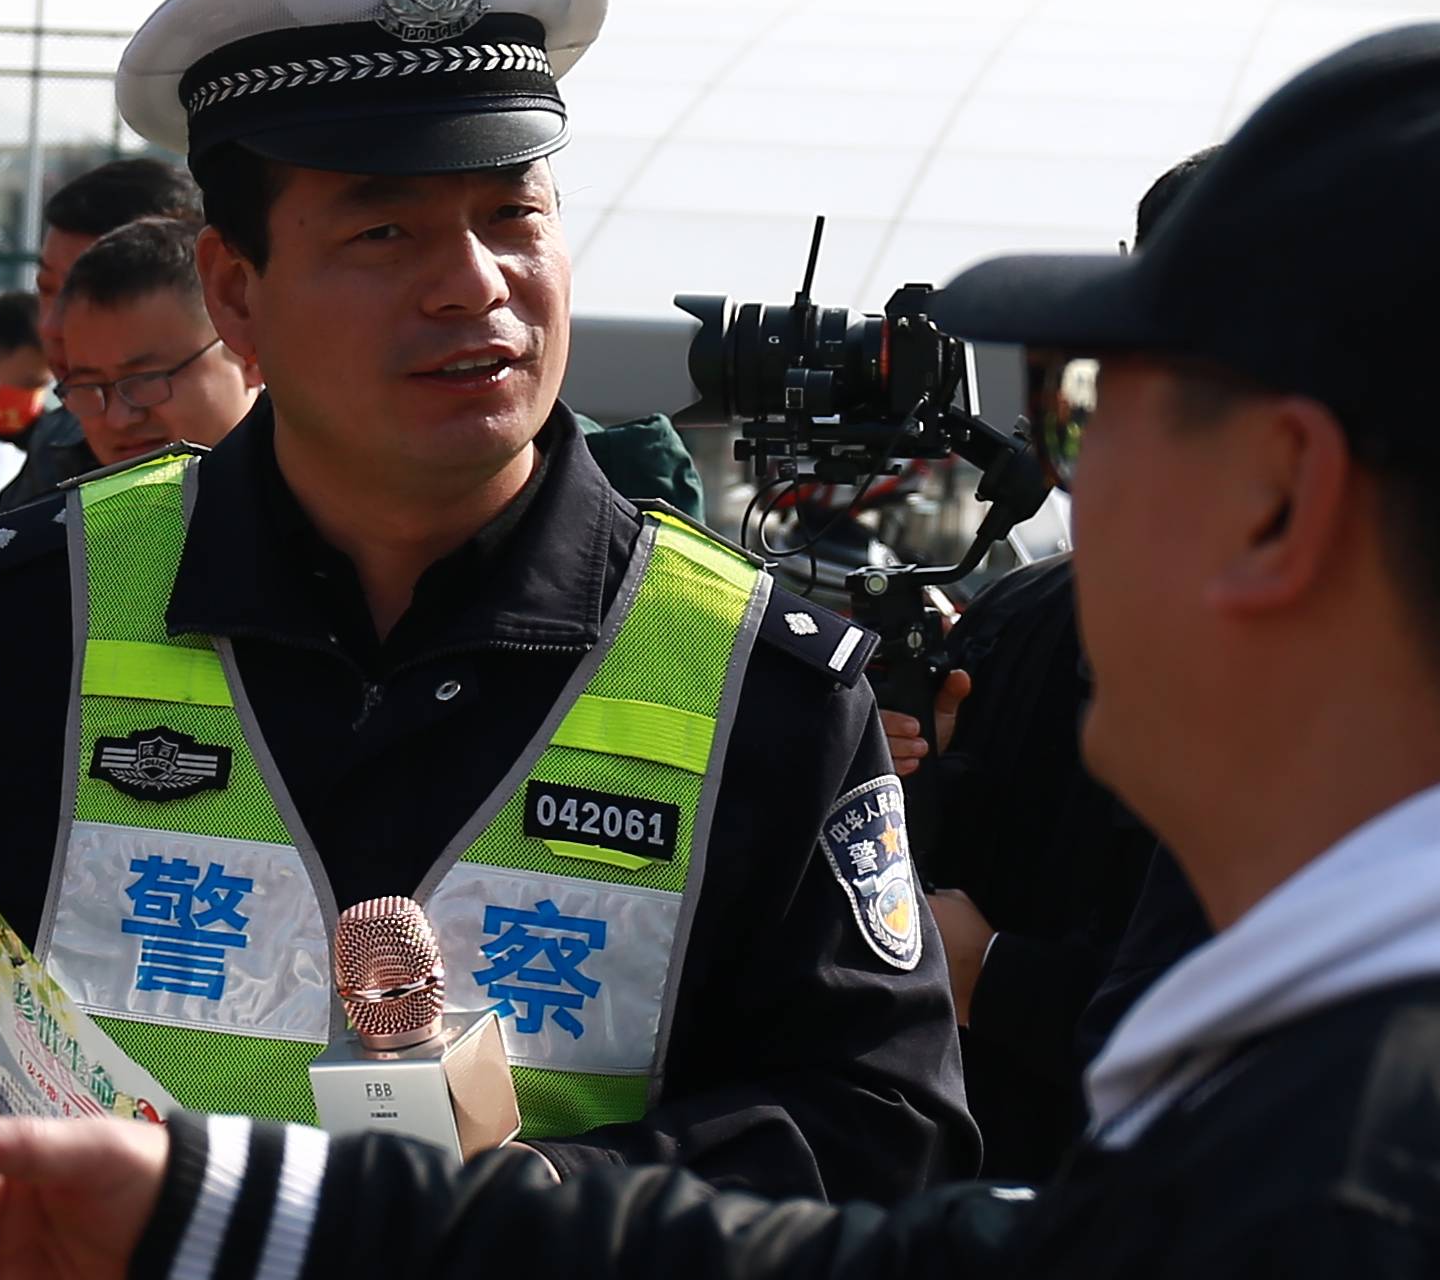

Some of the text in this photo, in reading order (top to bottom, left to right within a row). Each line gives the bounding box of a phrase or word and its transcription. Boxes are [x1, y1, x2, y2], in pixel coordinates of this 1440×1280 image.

[405, 25, 460, 43] POLICE
[138, 758, 172, 772] POLICE
[536, 794, 665, 846] 042061
[846, 838, 878, 877] 警
[119, 852, 256, 1002] 警
[475, 899, 607, 1040] 察
[365, 1082, 393, 1098] FBB
